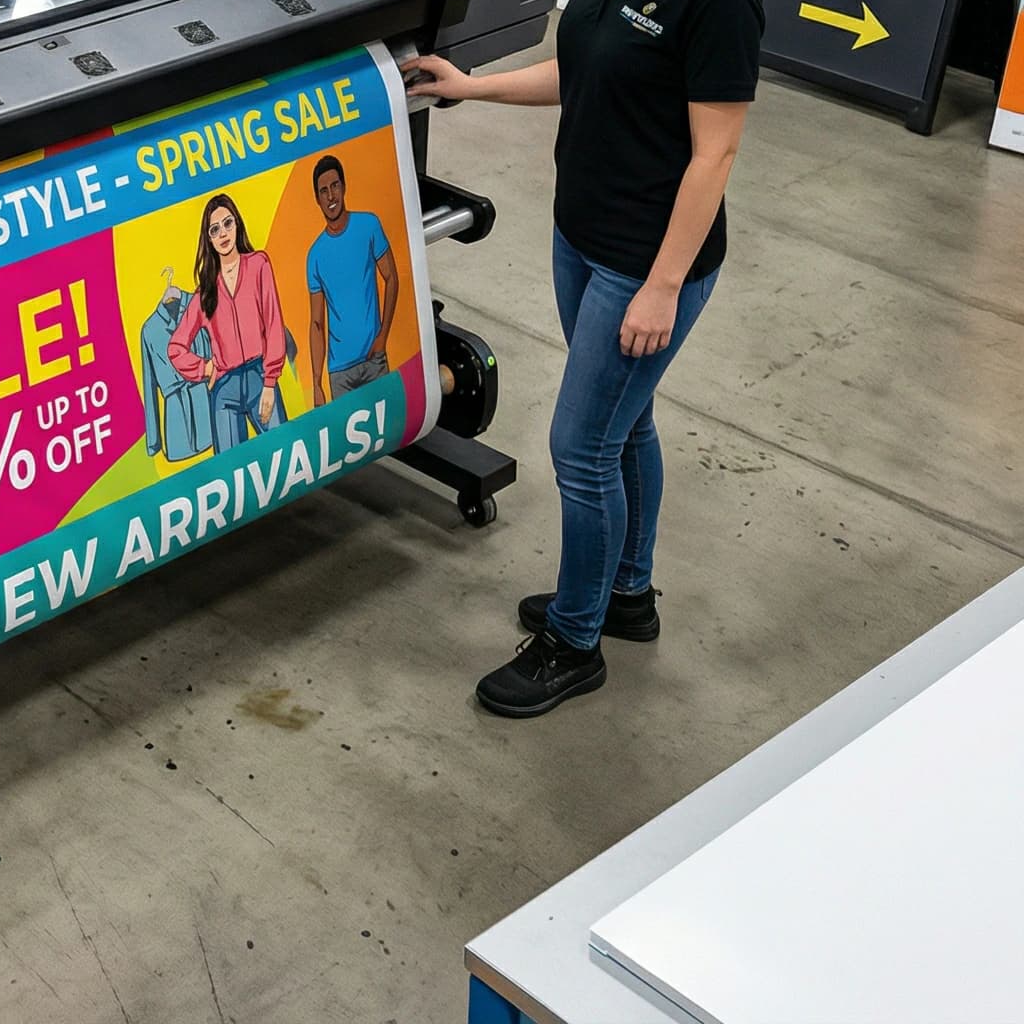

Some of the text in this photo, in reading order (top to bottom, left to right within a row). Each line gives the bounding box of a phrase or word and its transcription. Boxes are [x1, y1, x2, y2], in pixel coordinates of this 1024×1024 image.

[136, 109, 271, 192] SPRING
[279, 77, 360, 144] SALE
[37, 381, 108, 430] UP TO
[46, 414, 111, 473] OFF
[115, 400, 386, 578] ARRIVALS!
